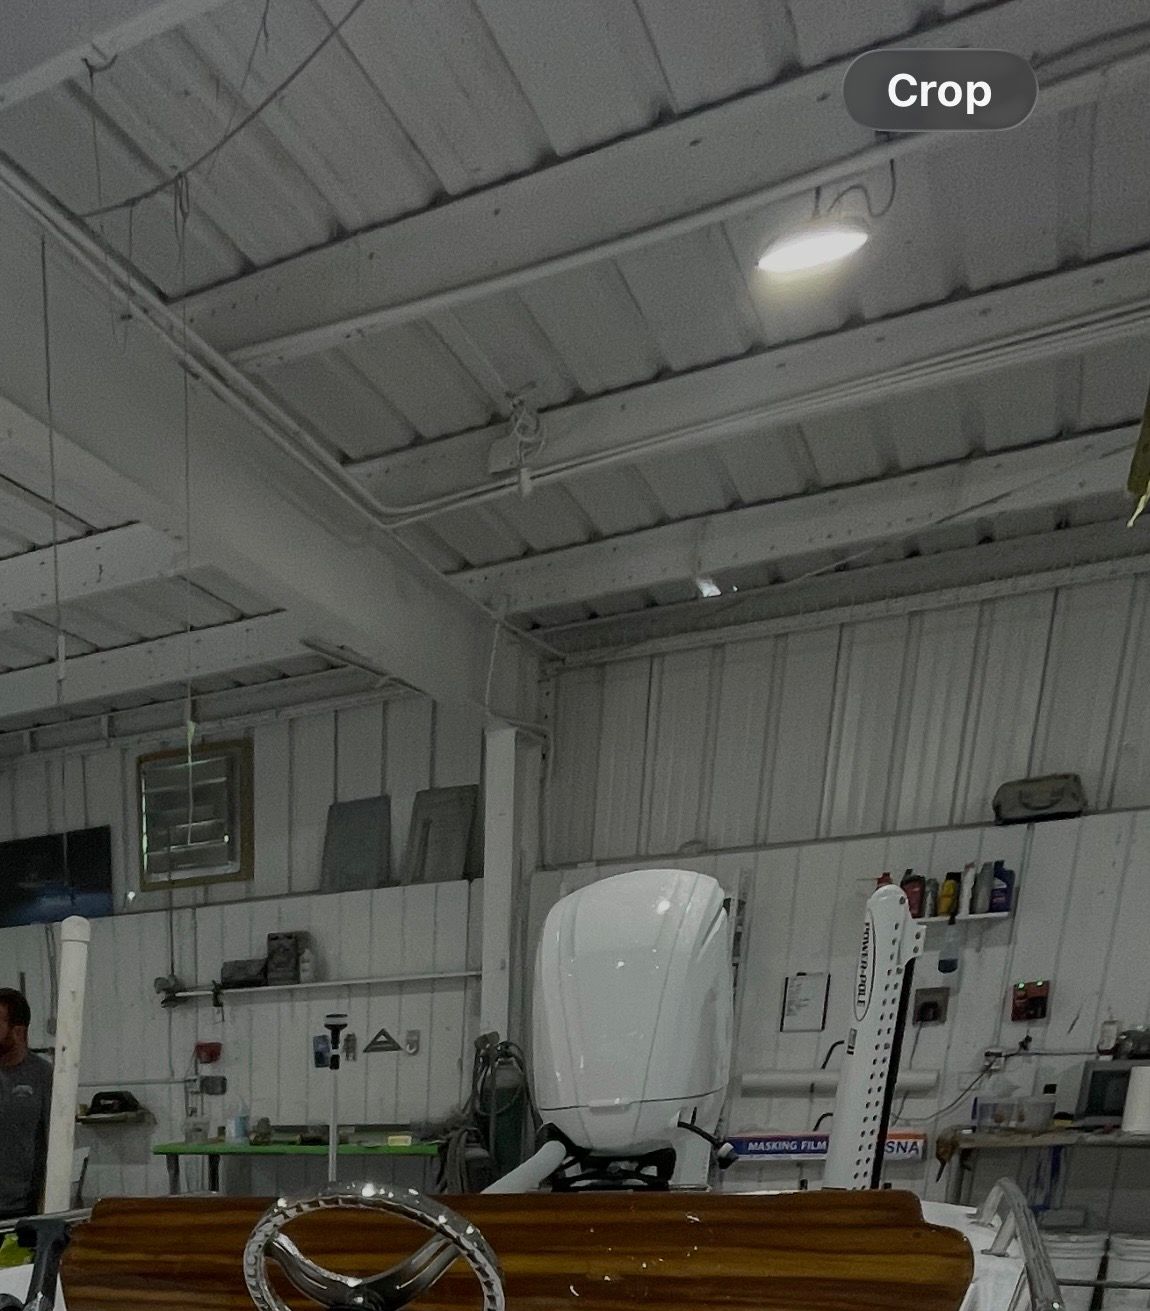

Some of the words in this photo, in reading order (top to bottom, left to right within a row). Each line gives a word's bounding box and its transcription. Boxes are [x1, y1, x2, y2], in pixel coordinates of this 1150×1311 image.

[856, 922, 870, 1008] POWER-POLE
[747, 1140, 797, 1151] MASKING
[800, 1140, 827, 1150] FILM
[884, 1140, 920, 1154] SNA
